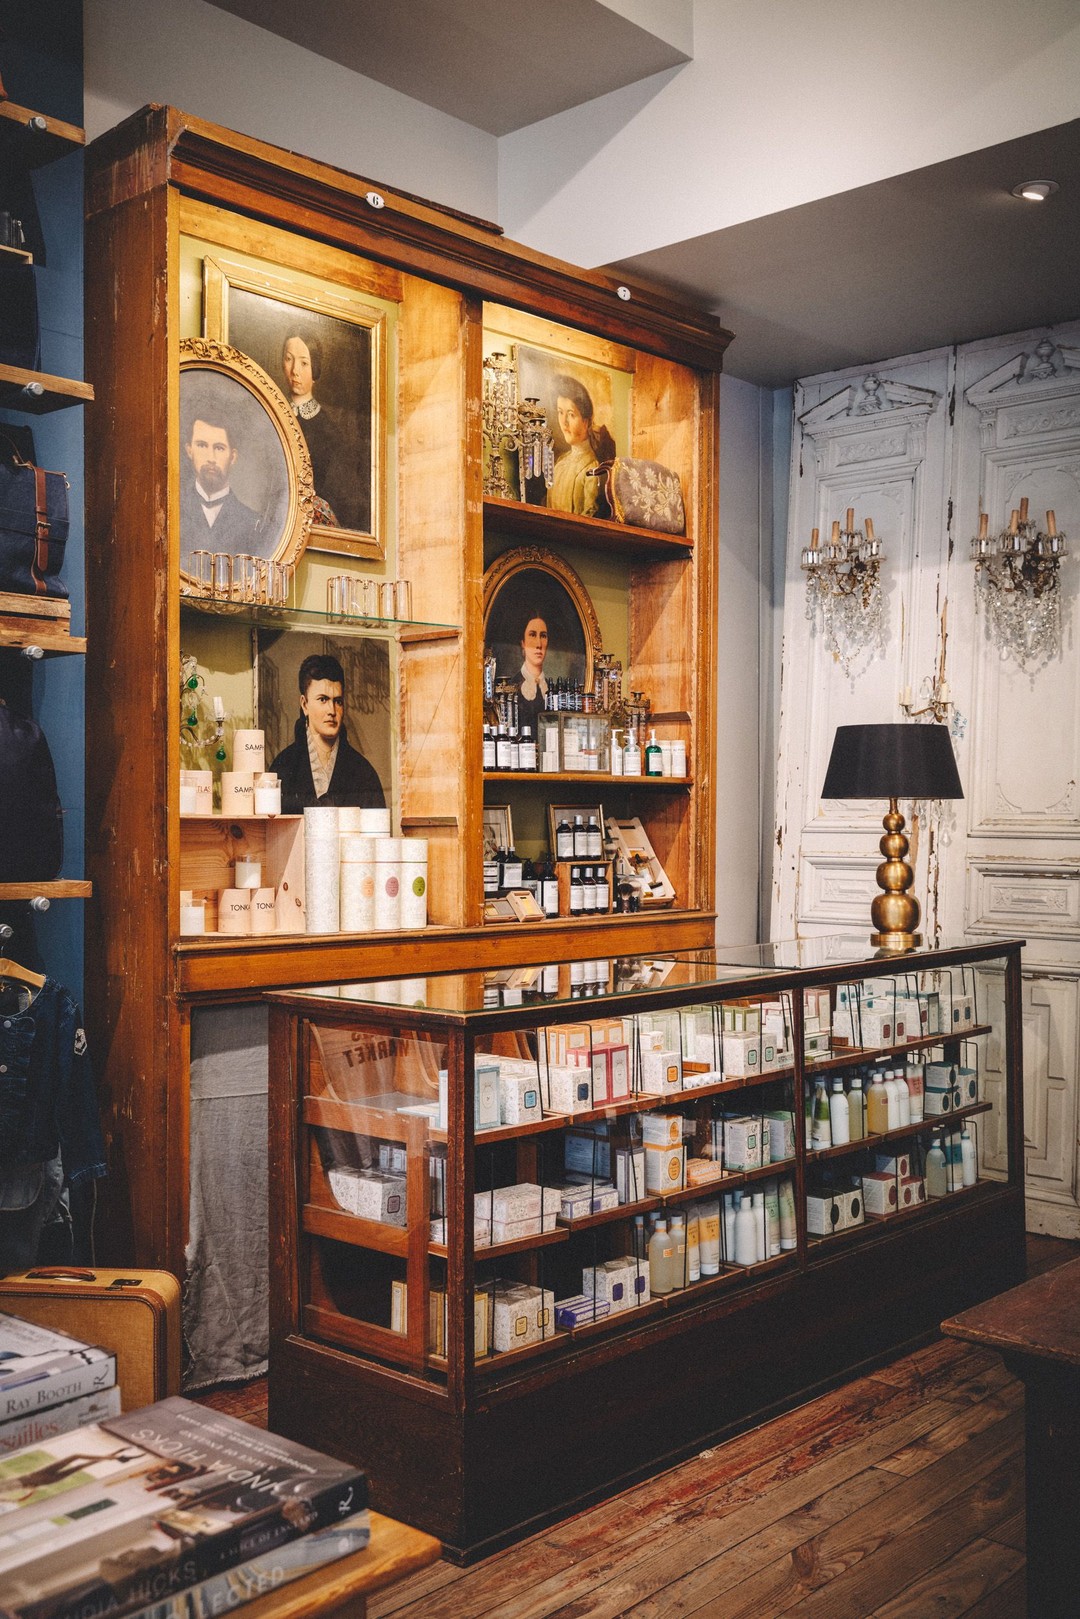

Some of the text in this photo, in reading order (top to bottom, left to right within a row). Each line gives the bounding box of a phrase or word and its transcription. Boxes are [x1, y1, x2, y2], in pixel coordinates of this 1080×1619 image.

[372, 195, 379, 206] 6
[6, 1381, 82, 1415] RAY BOOTH
[130, 1428, 207, 1463] HICKS
